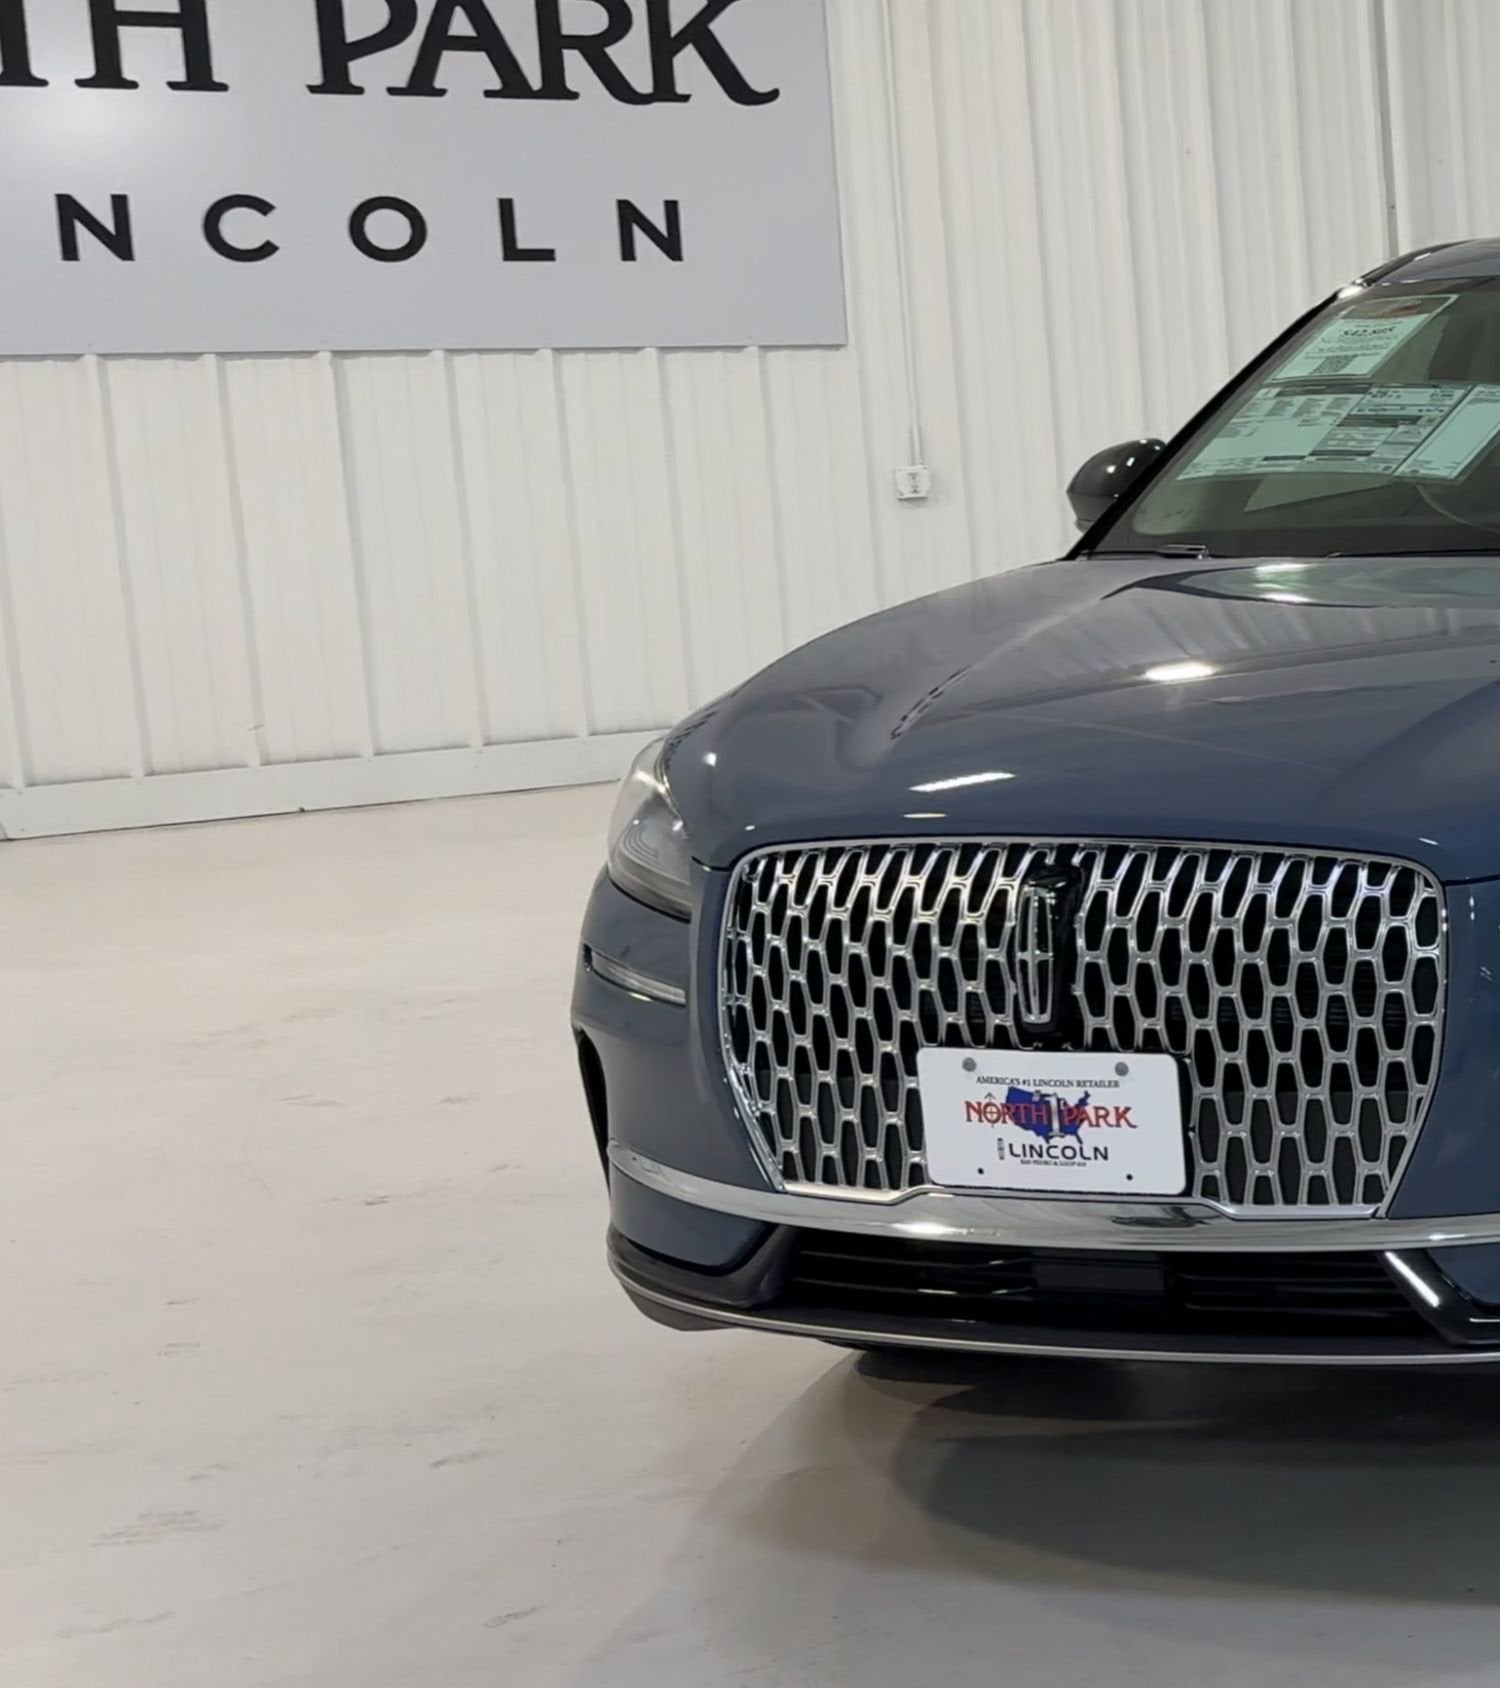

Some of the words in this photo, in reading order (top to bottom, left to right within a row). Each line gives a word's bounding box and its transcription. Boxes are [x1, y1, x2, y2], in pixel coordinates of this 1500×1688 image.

[306, 0, 780, 106] PARK
[976, 1076, 1020, 1086] AMERICA'S
[1022, 1078, 1031, 1087] #1
[1033, 1079, 1074, 1088] LINCOLN
[1076, 1080, 1120, 1088] RETAILER
[965, 1101, 1049, 1126] NORTH
[1064, 1105, 1138, 1128] PARK
[1009, 1143, 1109, 1161] LINCOLN
